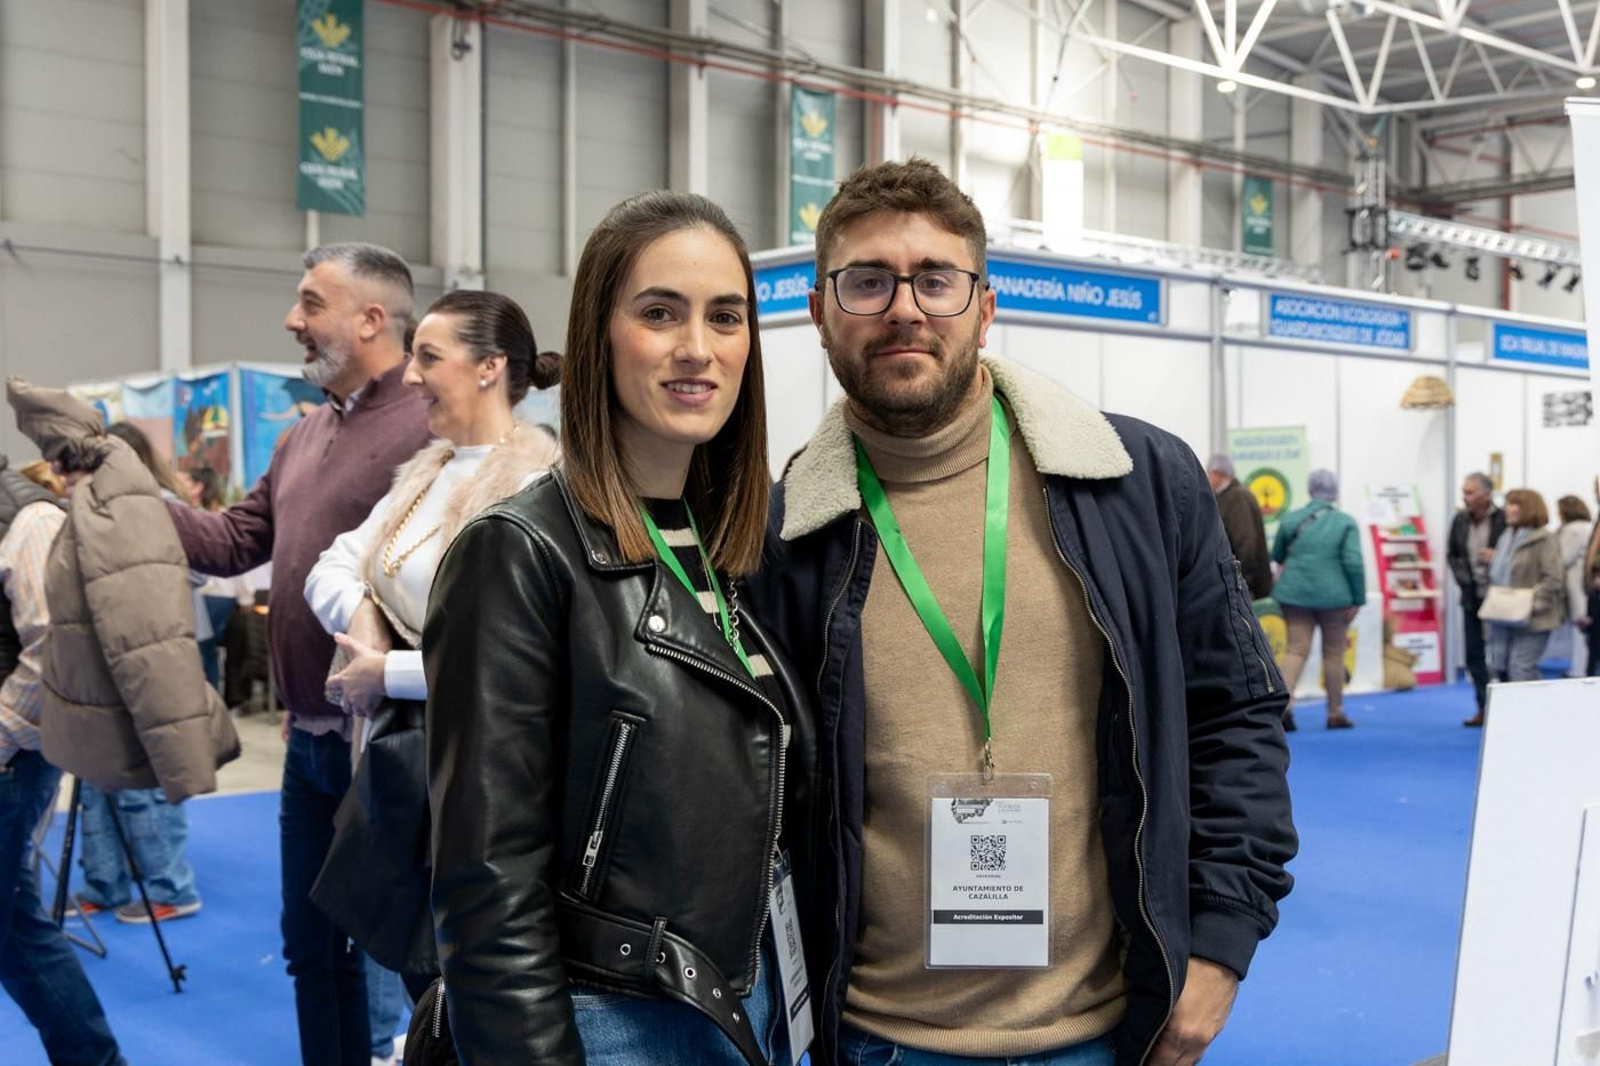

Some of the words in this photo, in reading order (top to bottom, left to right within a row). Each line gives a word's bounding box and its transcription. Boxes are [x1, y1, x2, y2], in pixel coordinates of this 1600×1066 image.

[988, 273, 1066, 302] PANADERÍA
[1066, 281, 1104, 307] NIÑO
[1105, 286, 1143, 311] JESÚS
